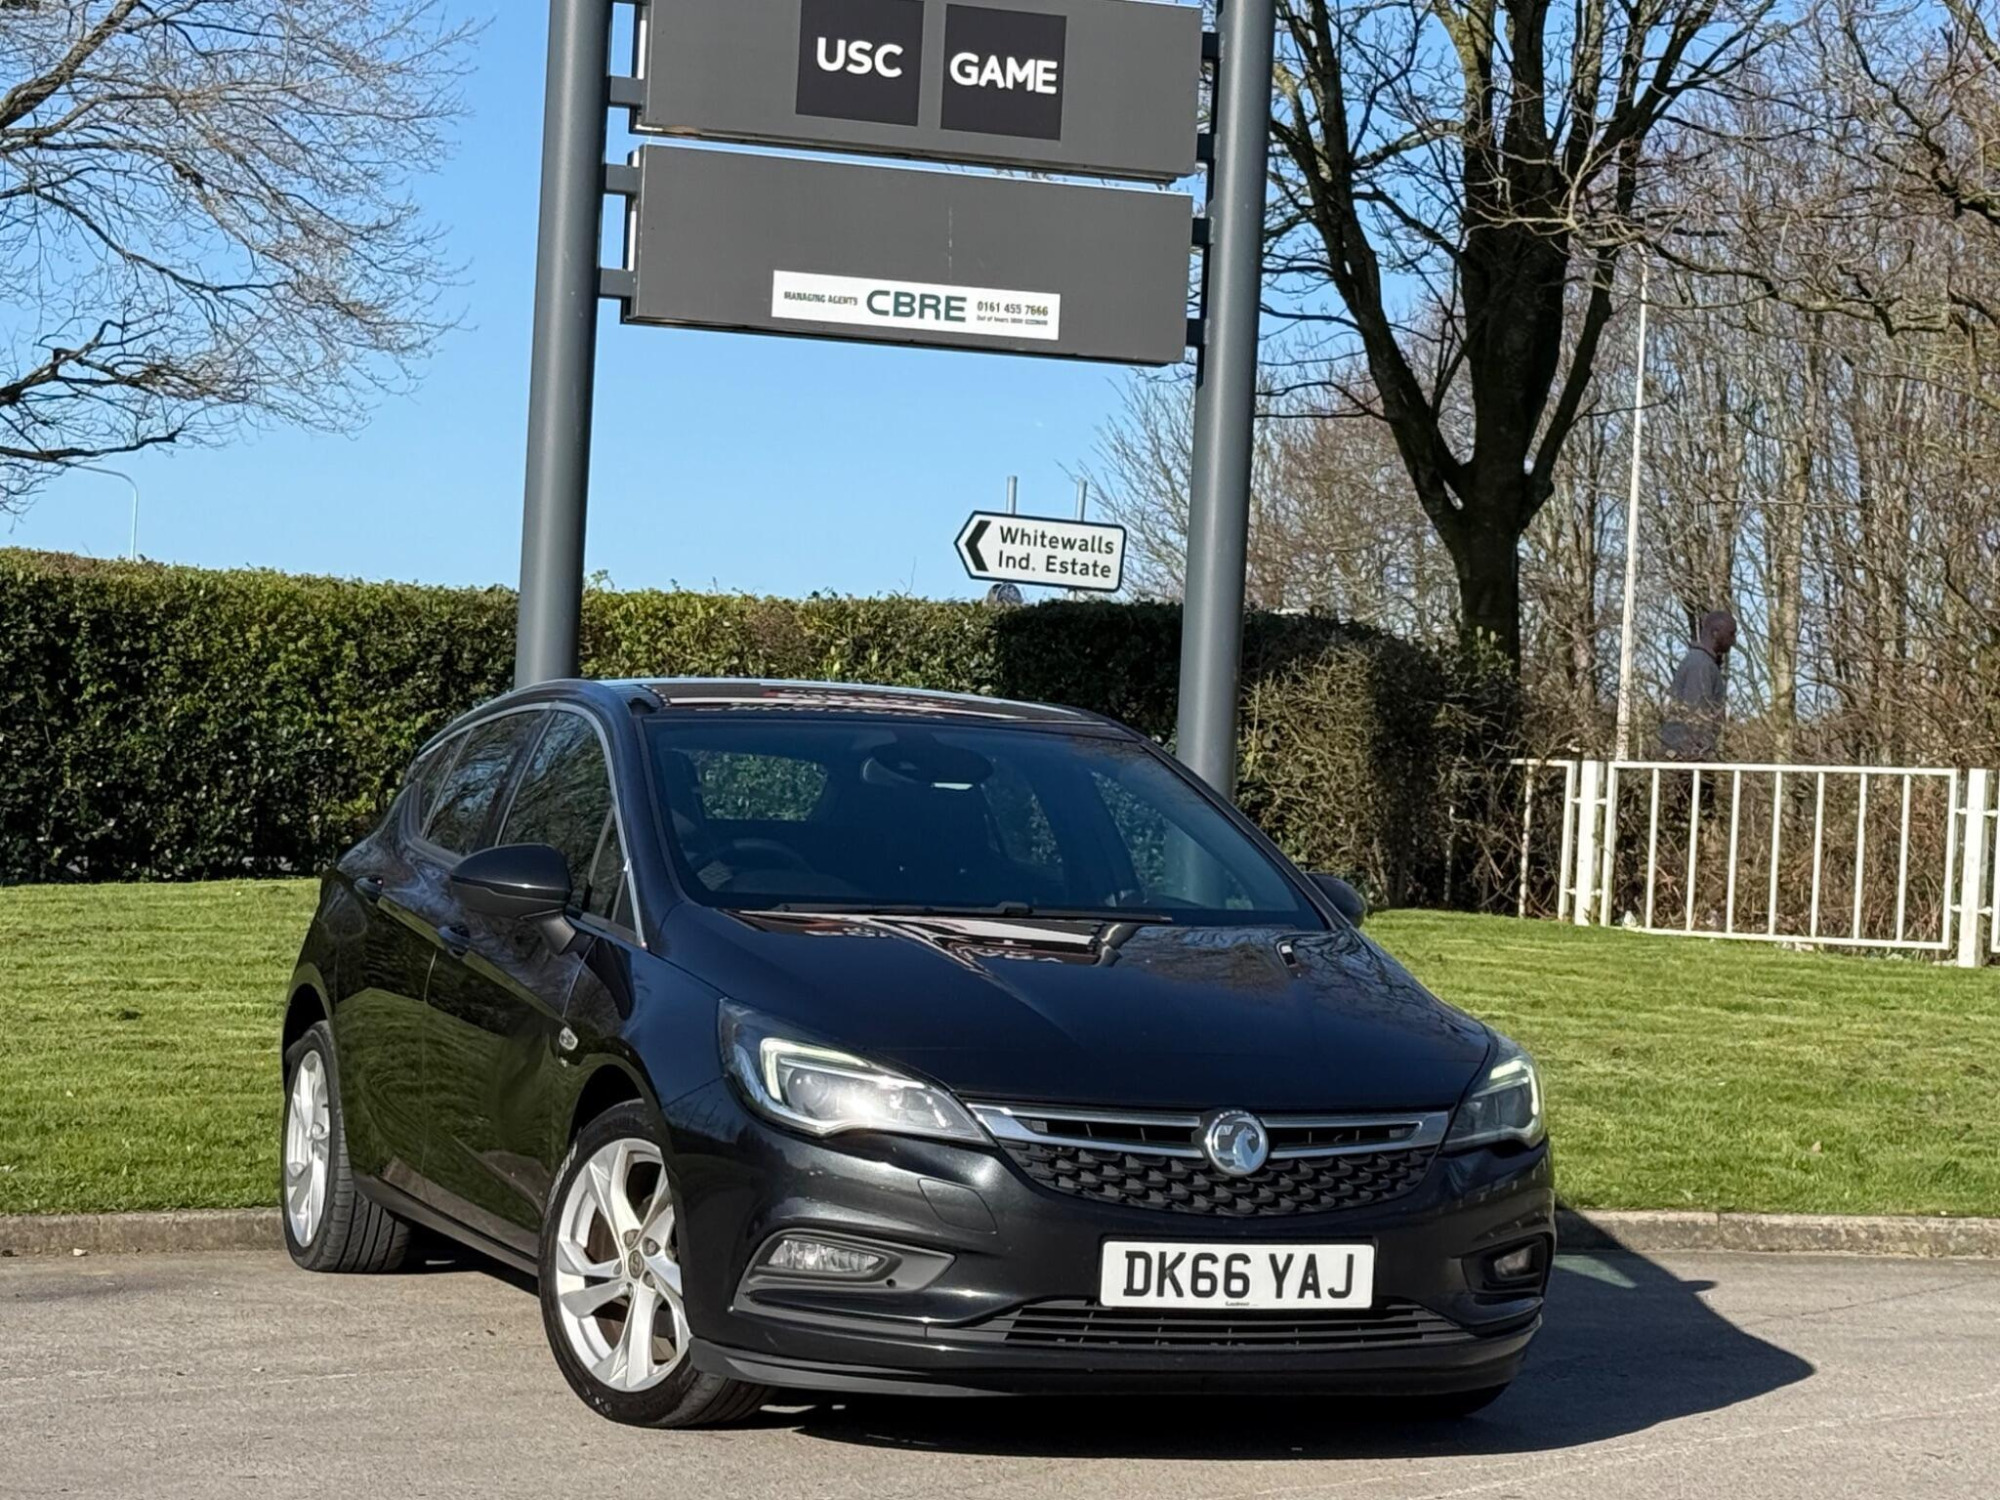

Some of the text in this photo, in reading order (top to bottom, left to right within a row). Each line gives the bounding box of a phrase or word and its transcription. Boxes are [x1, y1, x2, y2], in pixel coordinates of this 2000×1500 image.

[816, 37, 904, 78] USC
[949, 52, 1058, 94] GAME
[828, 294, 859, 306] AGENTS
[866, 289, 967, 323] CBRE
[977, 300, 1001, 313] 0161
[1004, 303, 1022, 315] 455
[999, 525, 1115, 555] Whitewalls
[998, 550, 1112, 579] Ind. Estate
[1123, 1250, 1355, 1300] DK66 YAJ
